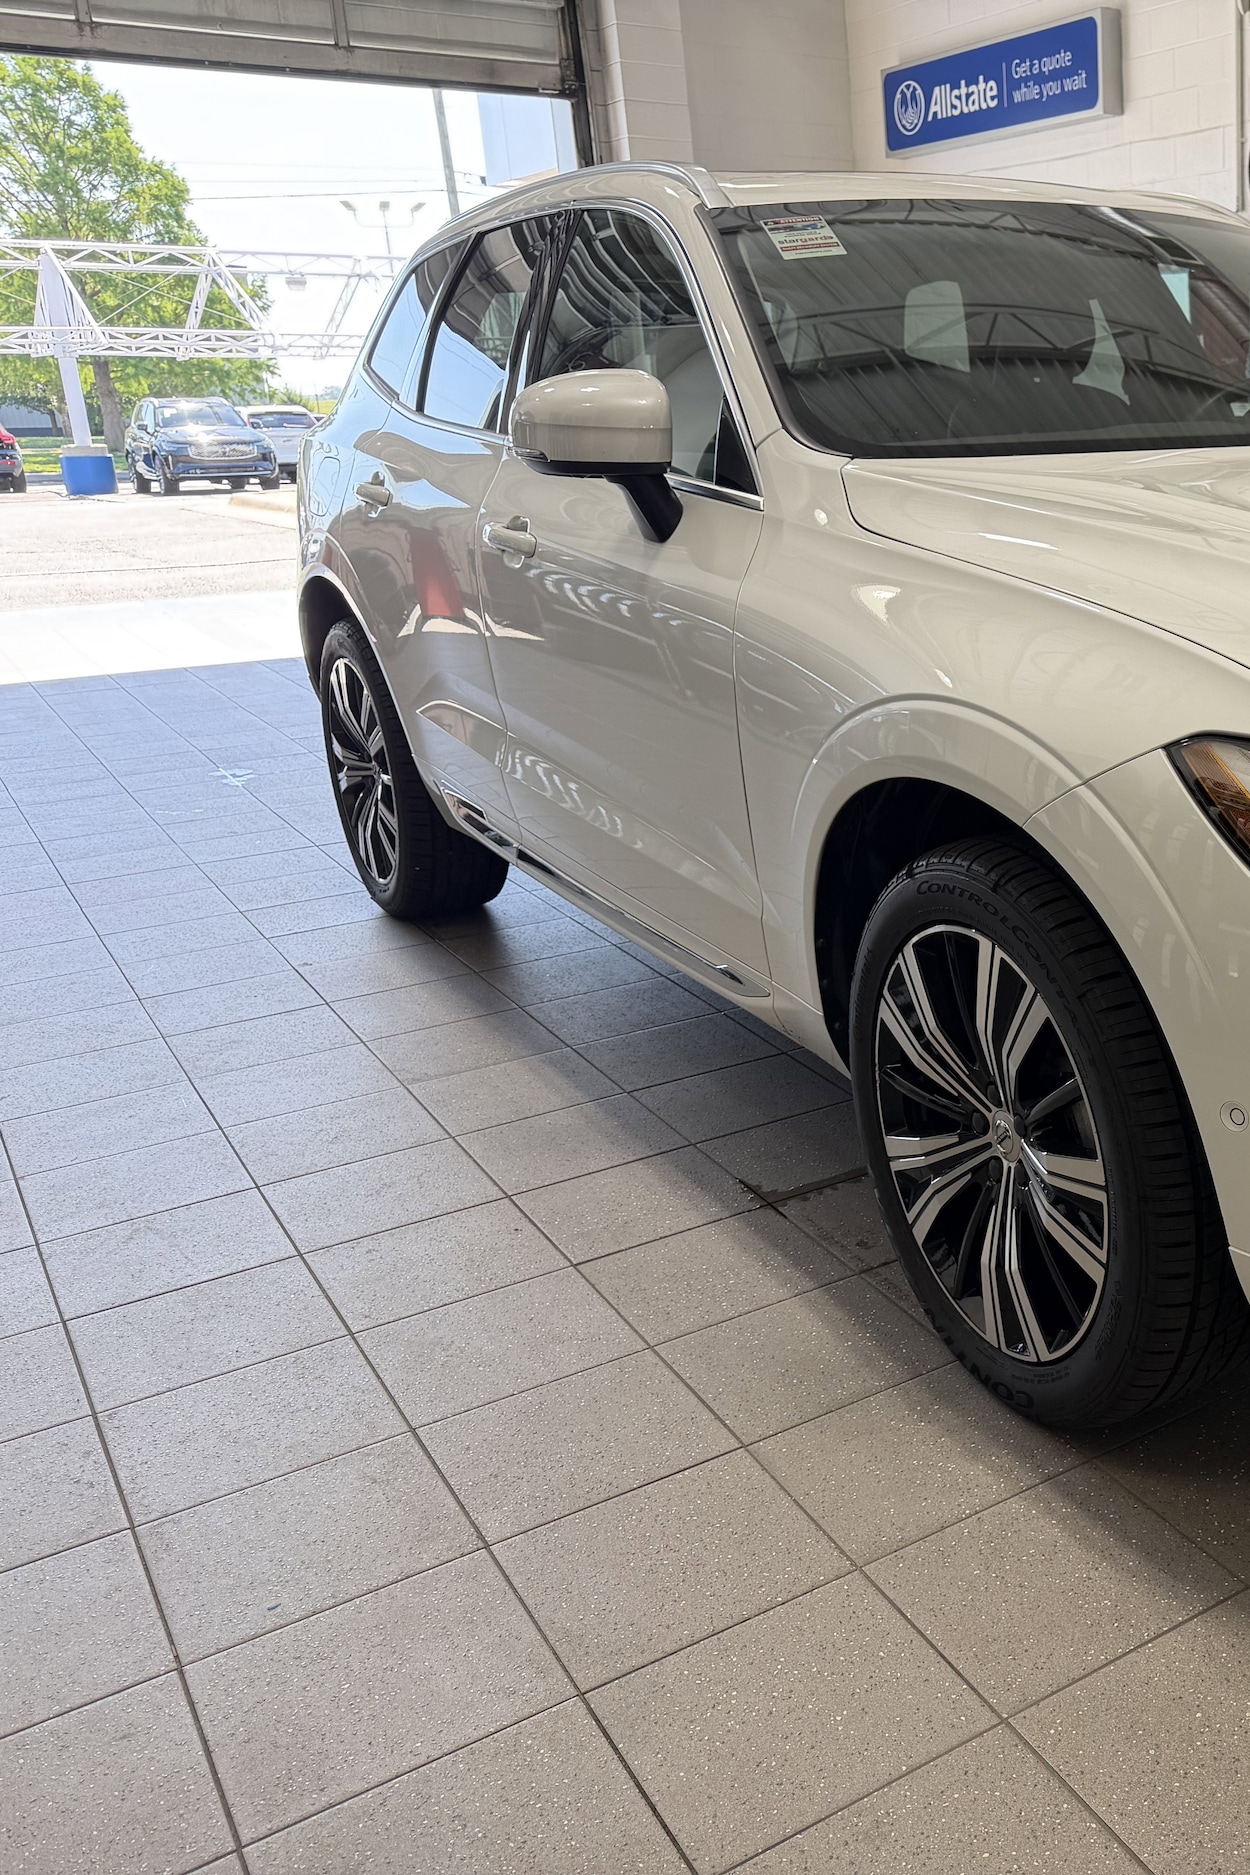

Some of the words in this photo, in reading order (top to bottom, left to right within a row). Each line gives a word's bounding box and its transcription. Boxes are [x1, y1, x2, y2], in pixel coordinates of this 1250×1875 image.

[1011, 58, 1031, 79] Get
[1032, 59, 1040, 74] a
[1041, 49, 1073, 73] quote
[927, 75, 999, 122] Allstate
[1012, 81, 1040, 104] while
[1041, 80, 1062, 102] you
[1063, 70, 1088, 92] wait
